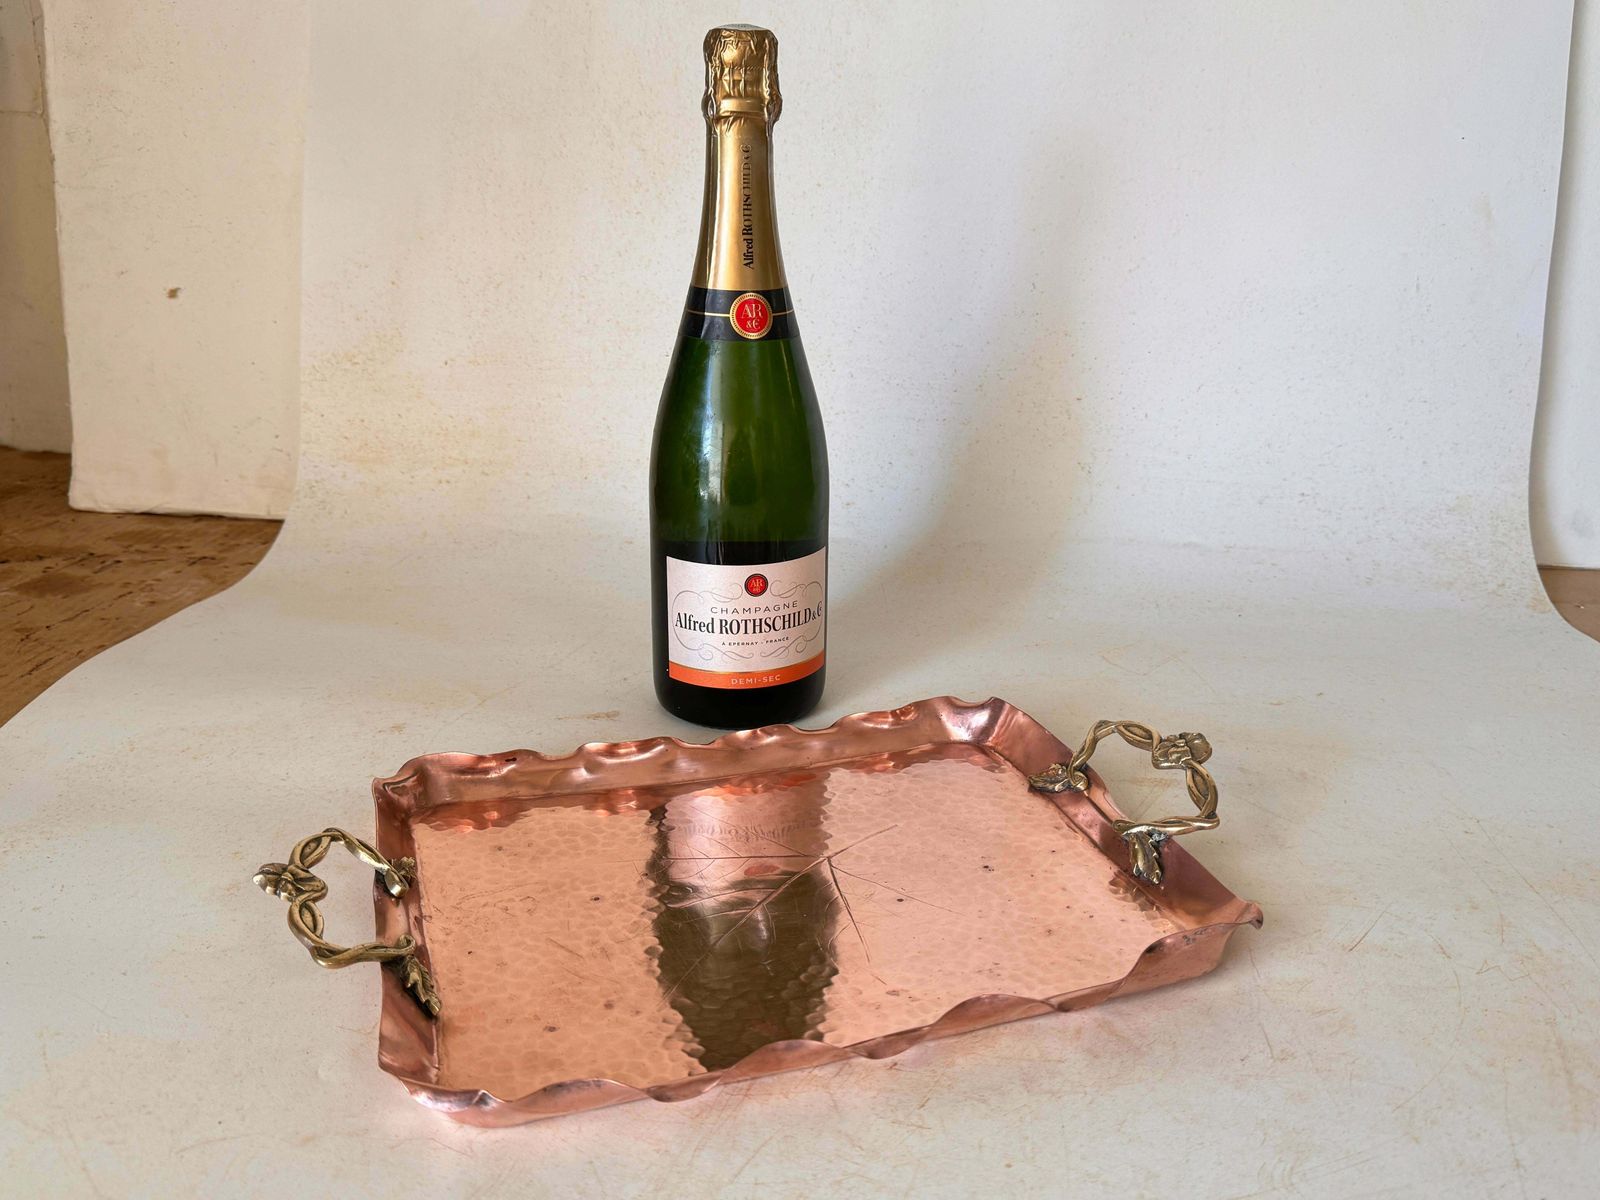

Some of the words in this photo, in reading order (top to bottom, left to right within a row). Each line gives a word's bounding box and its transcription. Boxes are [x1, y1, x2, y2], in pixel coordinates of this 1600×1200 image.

[741, 162, 754, 236] ROTHSCHILD
[742, 239, 754, 270] Alfred
[741, 303, 763, 319] AR
[710, 600, 799, 615] CHAMPAGNE
[674, 612, 715, 635] Alfred
[718, 607, 812, 636] ROTHSCHILD
[765, 636, 790, 645] FRANCE
[731, 674, 782, 685] DEMI-SEC
